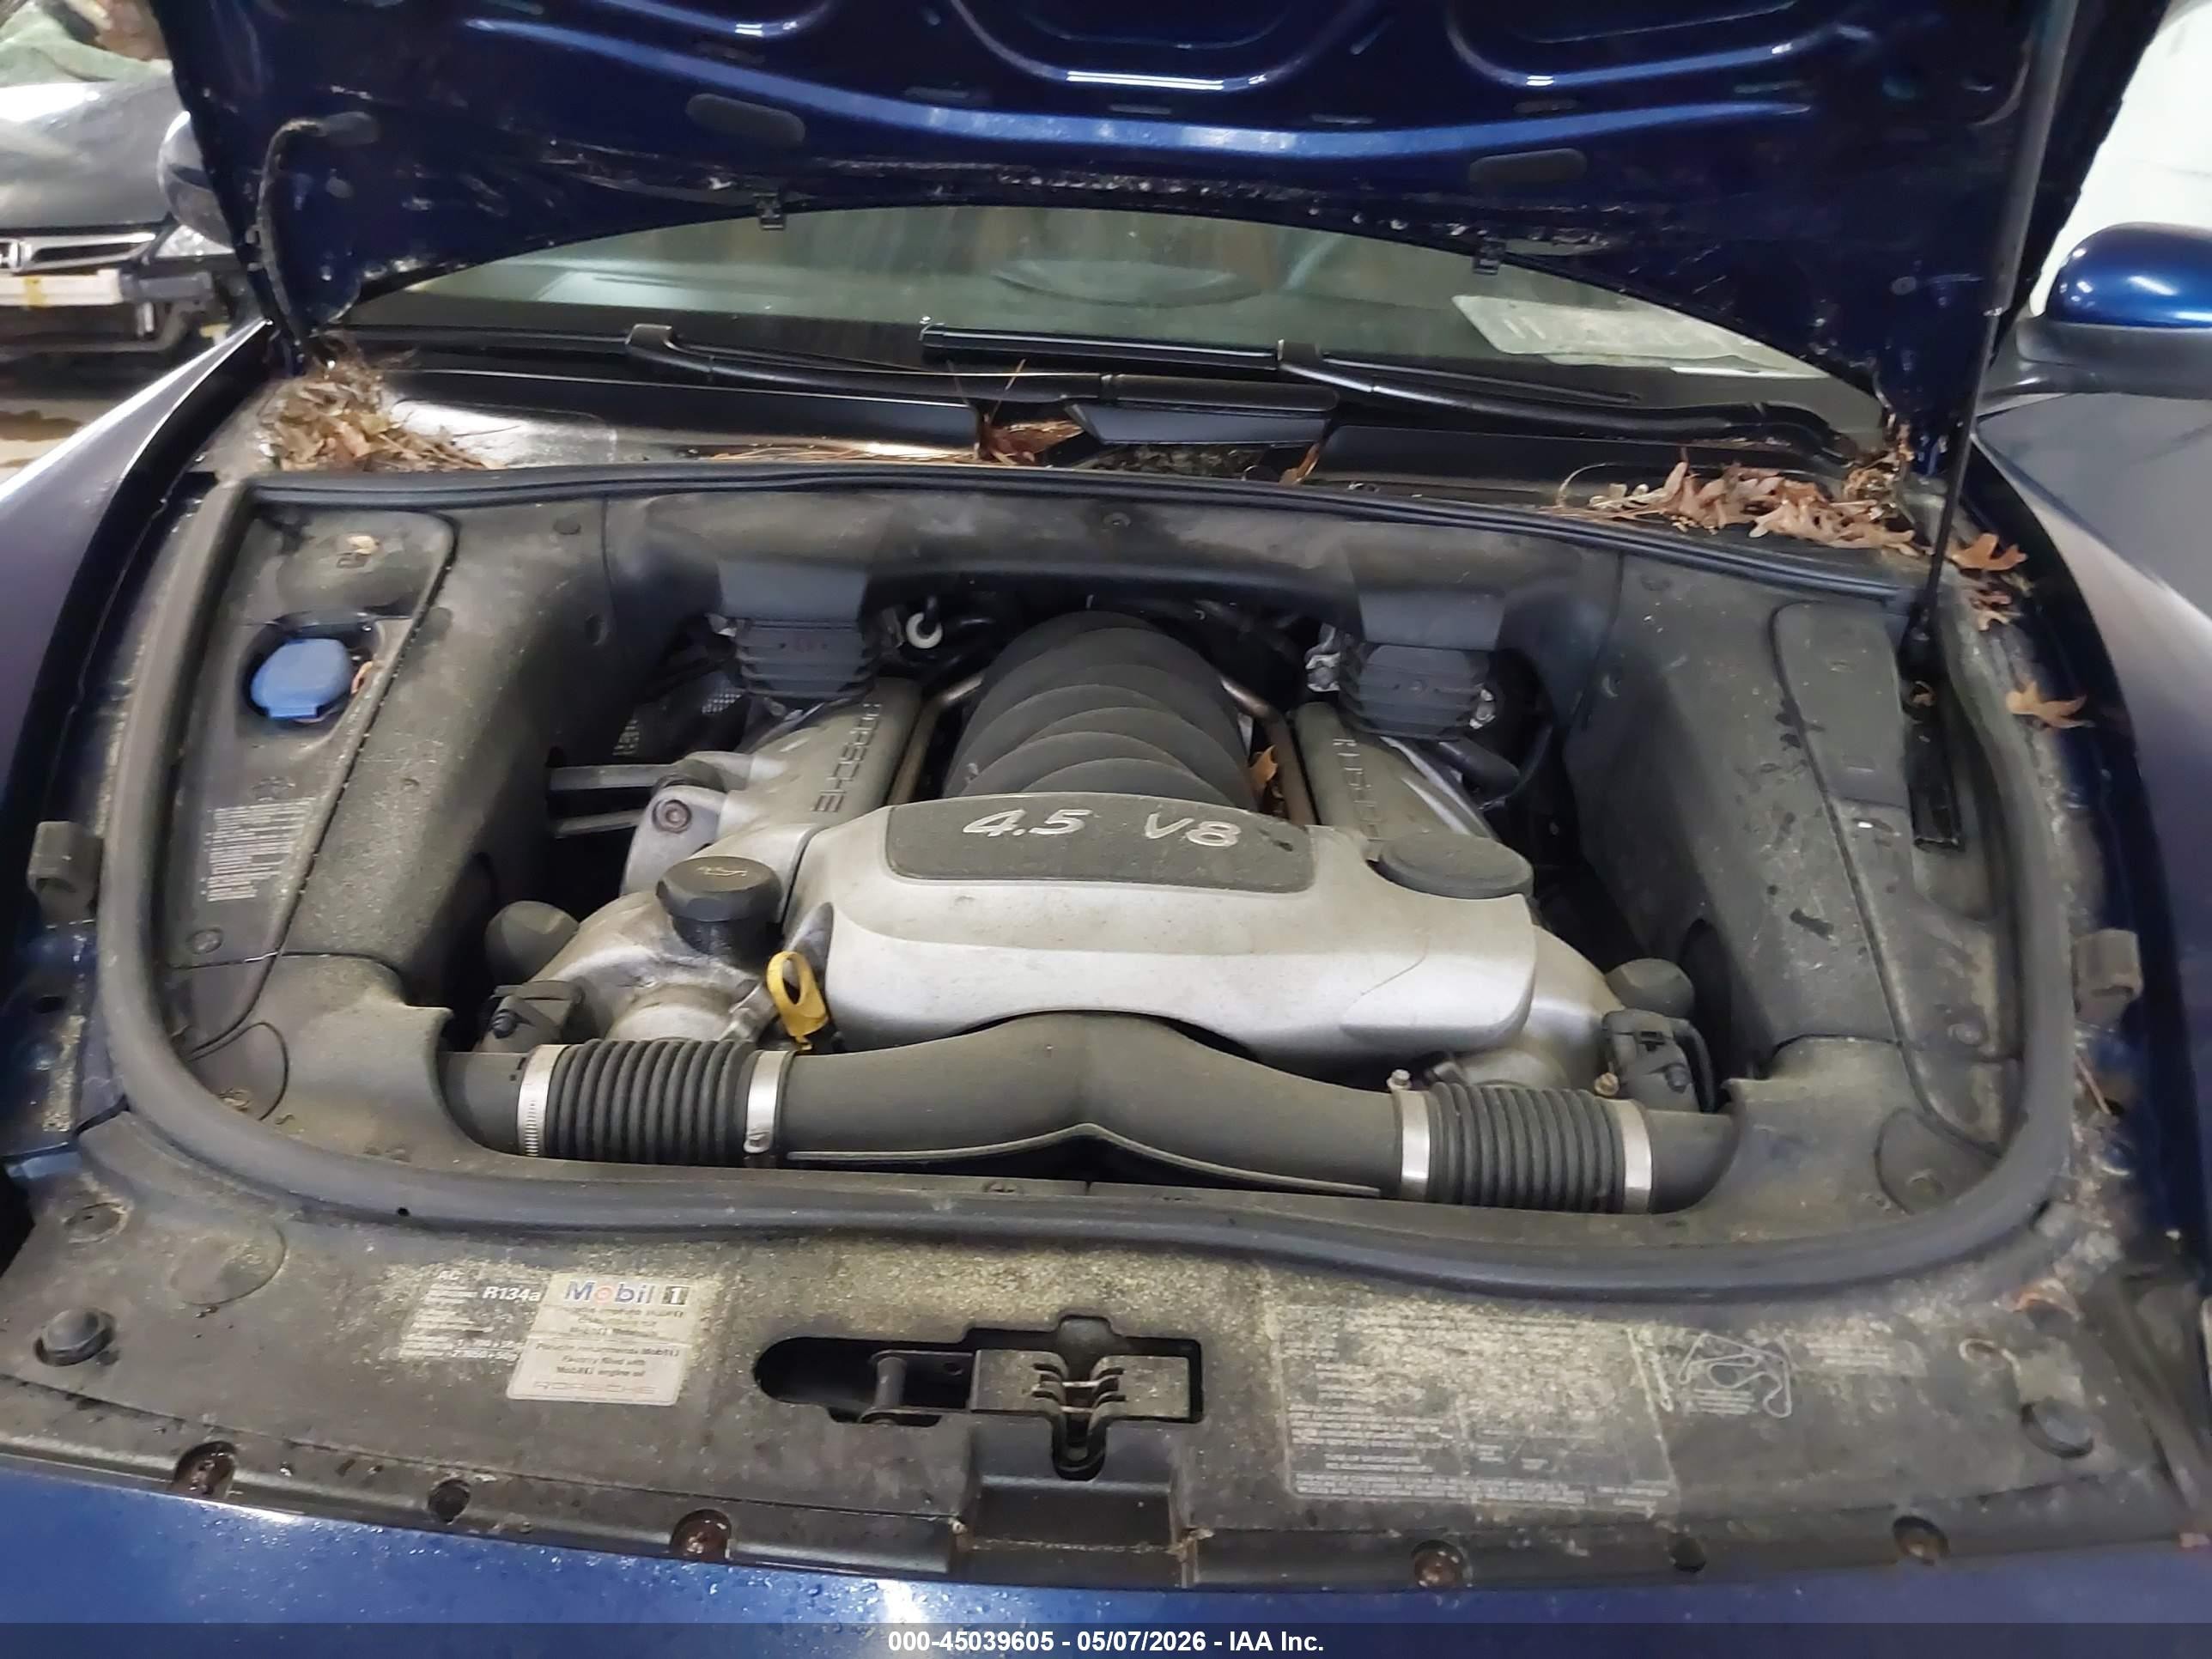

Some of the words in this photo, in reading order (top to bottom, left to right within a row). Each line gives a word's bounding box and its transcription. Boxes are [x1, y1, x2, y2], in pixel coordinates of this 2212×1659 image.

[962, 808, 1094, 838] 4.5
[1144, 812, 1243, 848] V8
[482, 1285, 542, 1302] R134a
[563, 1280, 656, 1305] Mobil
[665, 1285, 689, 1305] 1
